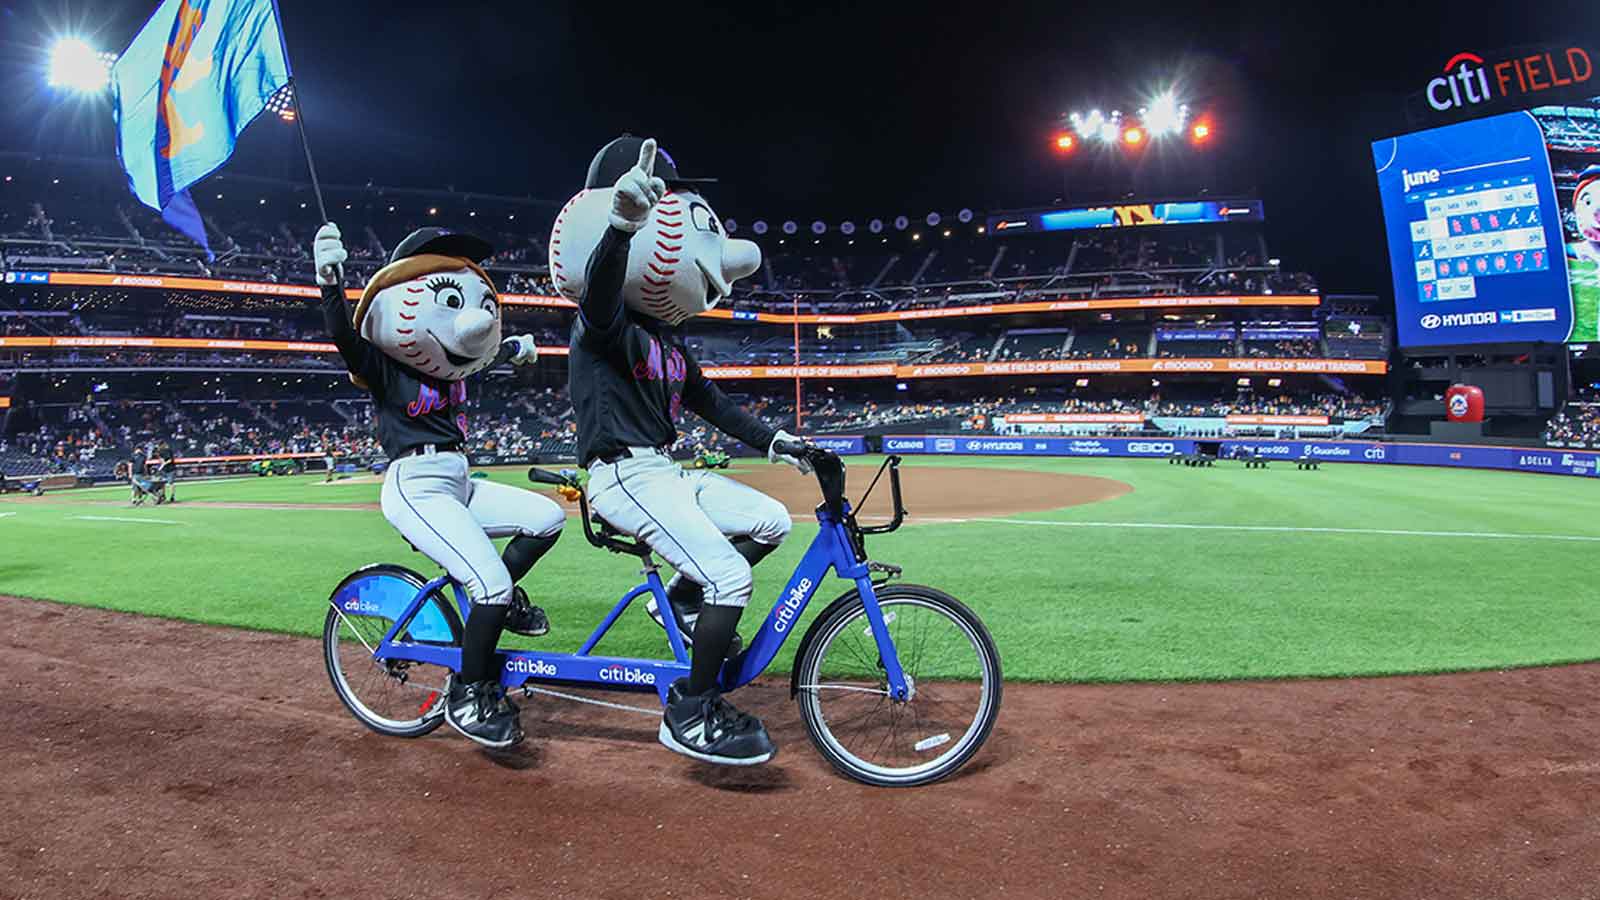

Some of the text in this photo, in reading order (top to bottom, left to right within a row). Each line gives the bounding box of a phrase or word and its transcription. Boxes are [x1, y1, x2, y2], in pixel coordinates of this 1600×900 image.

[1426, 48, 1593, 111] citi FIELD
[1403, 168, 1440, 192] june
[1442, 311, 1498, 326] HYUNDAI
[982, 442, 1024, 451] HYUNDAI
[1128, 442, 1174, 453] GEICO
[1313, 446, 1350, 456] Guardian
[1527, 456, 1552, 466] DELTA
[785, 577, 813, 610] bike
[506, 659, 557, 678] citi bike
[599, 667, 655, 687] citi bike
